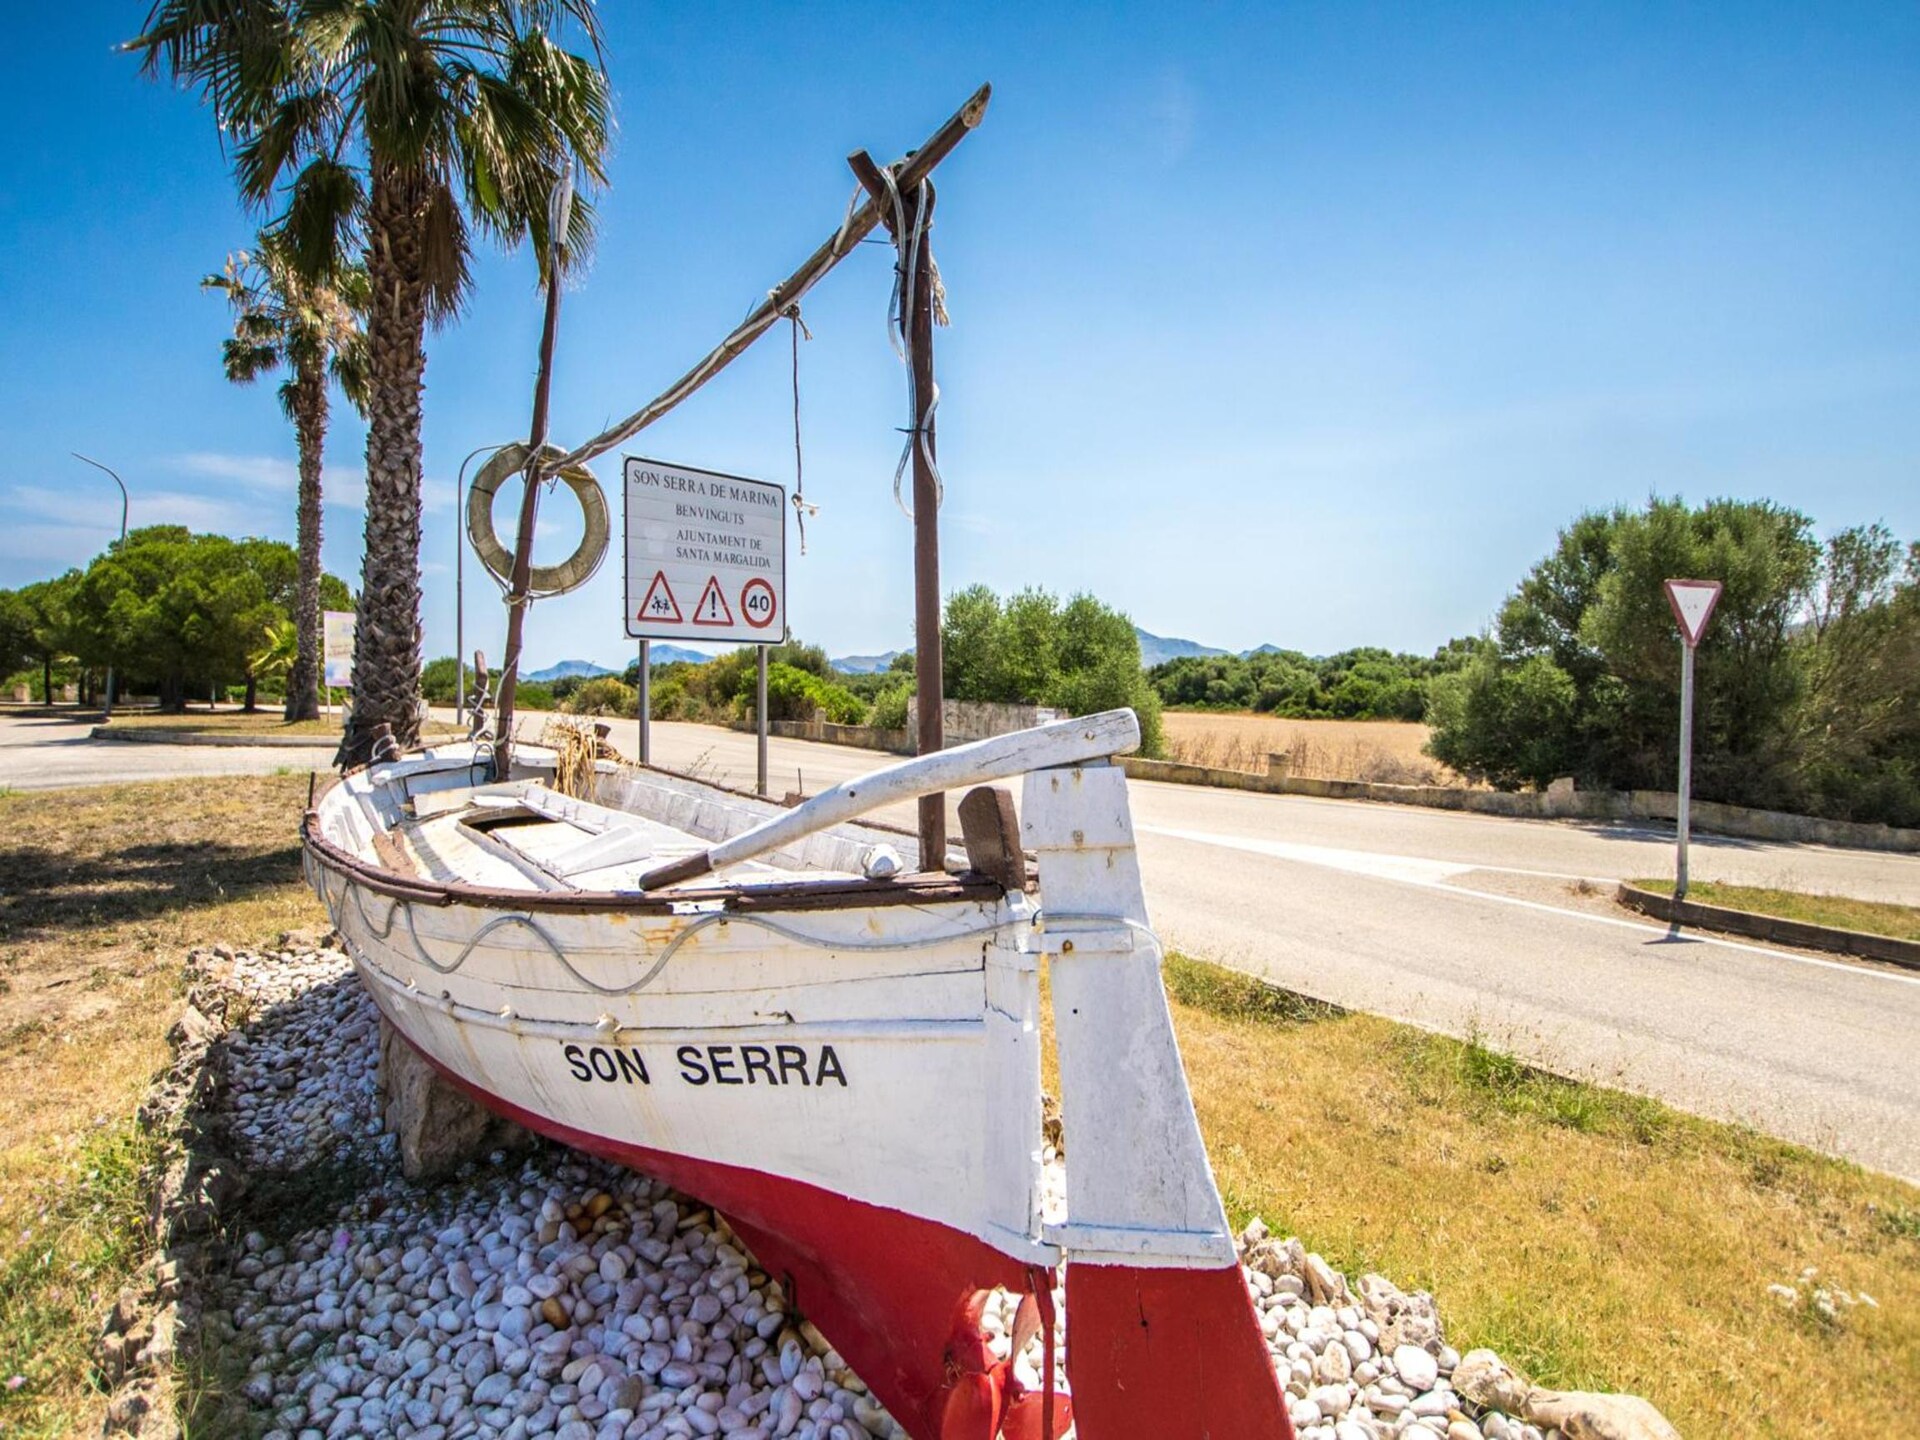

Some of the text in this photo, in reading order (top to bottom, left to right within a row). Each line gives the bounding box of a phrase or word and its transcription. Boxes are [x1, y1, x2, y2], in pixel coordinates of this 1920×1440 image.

[633, 468, 778, 508] SON SERRA DE MARINA
[676, 503, 745, 526] BENVINGUTS
[676, 529, 762, 551] AJUNTAMENT DE
[676, 547, 771, 569] SANTA MARGALIDA
[748, 595, 770, 612] 40
[564, 1044, 848, 1087] SON SERRA
